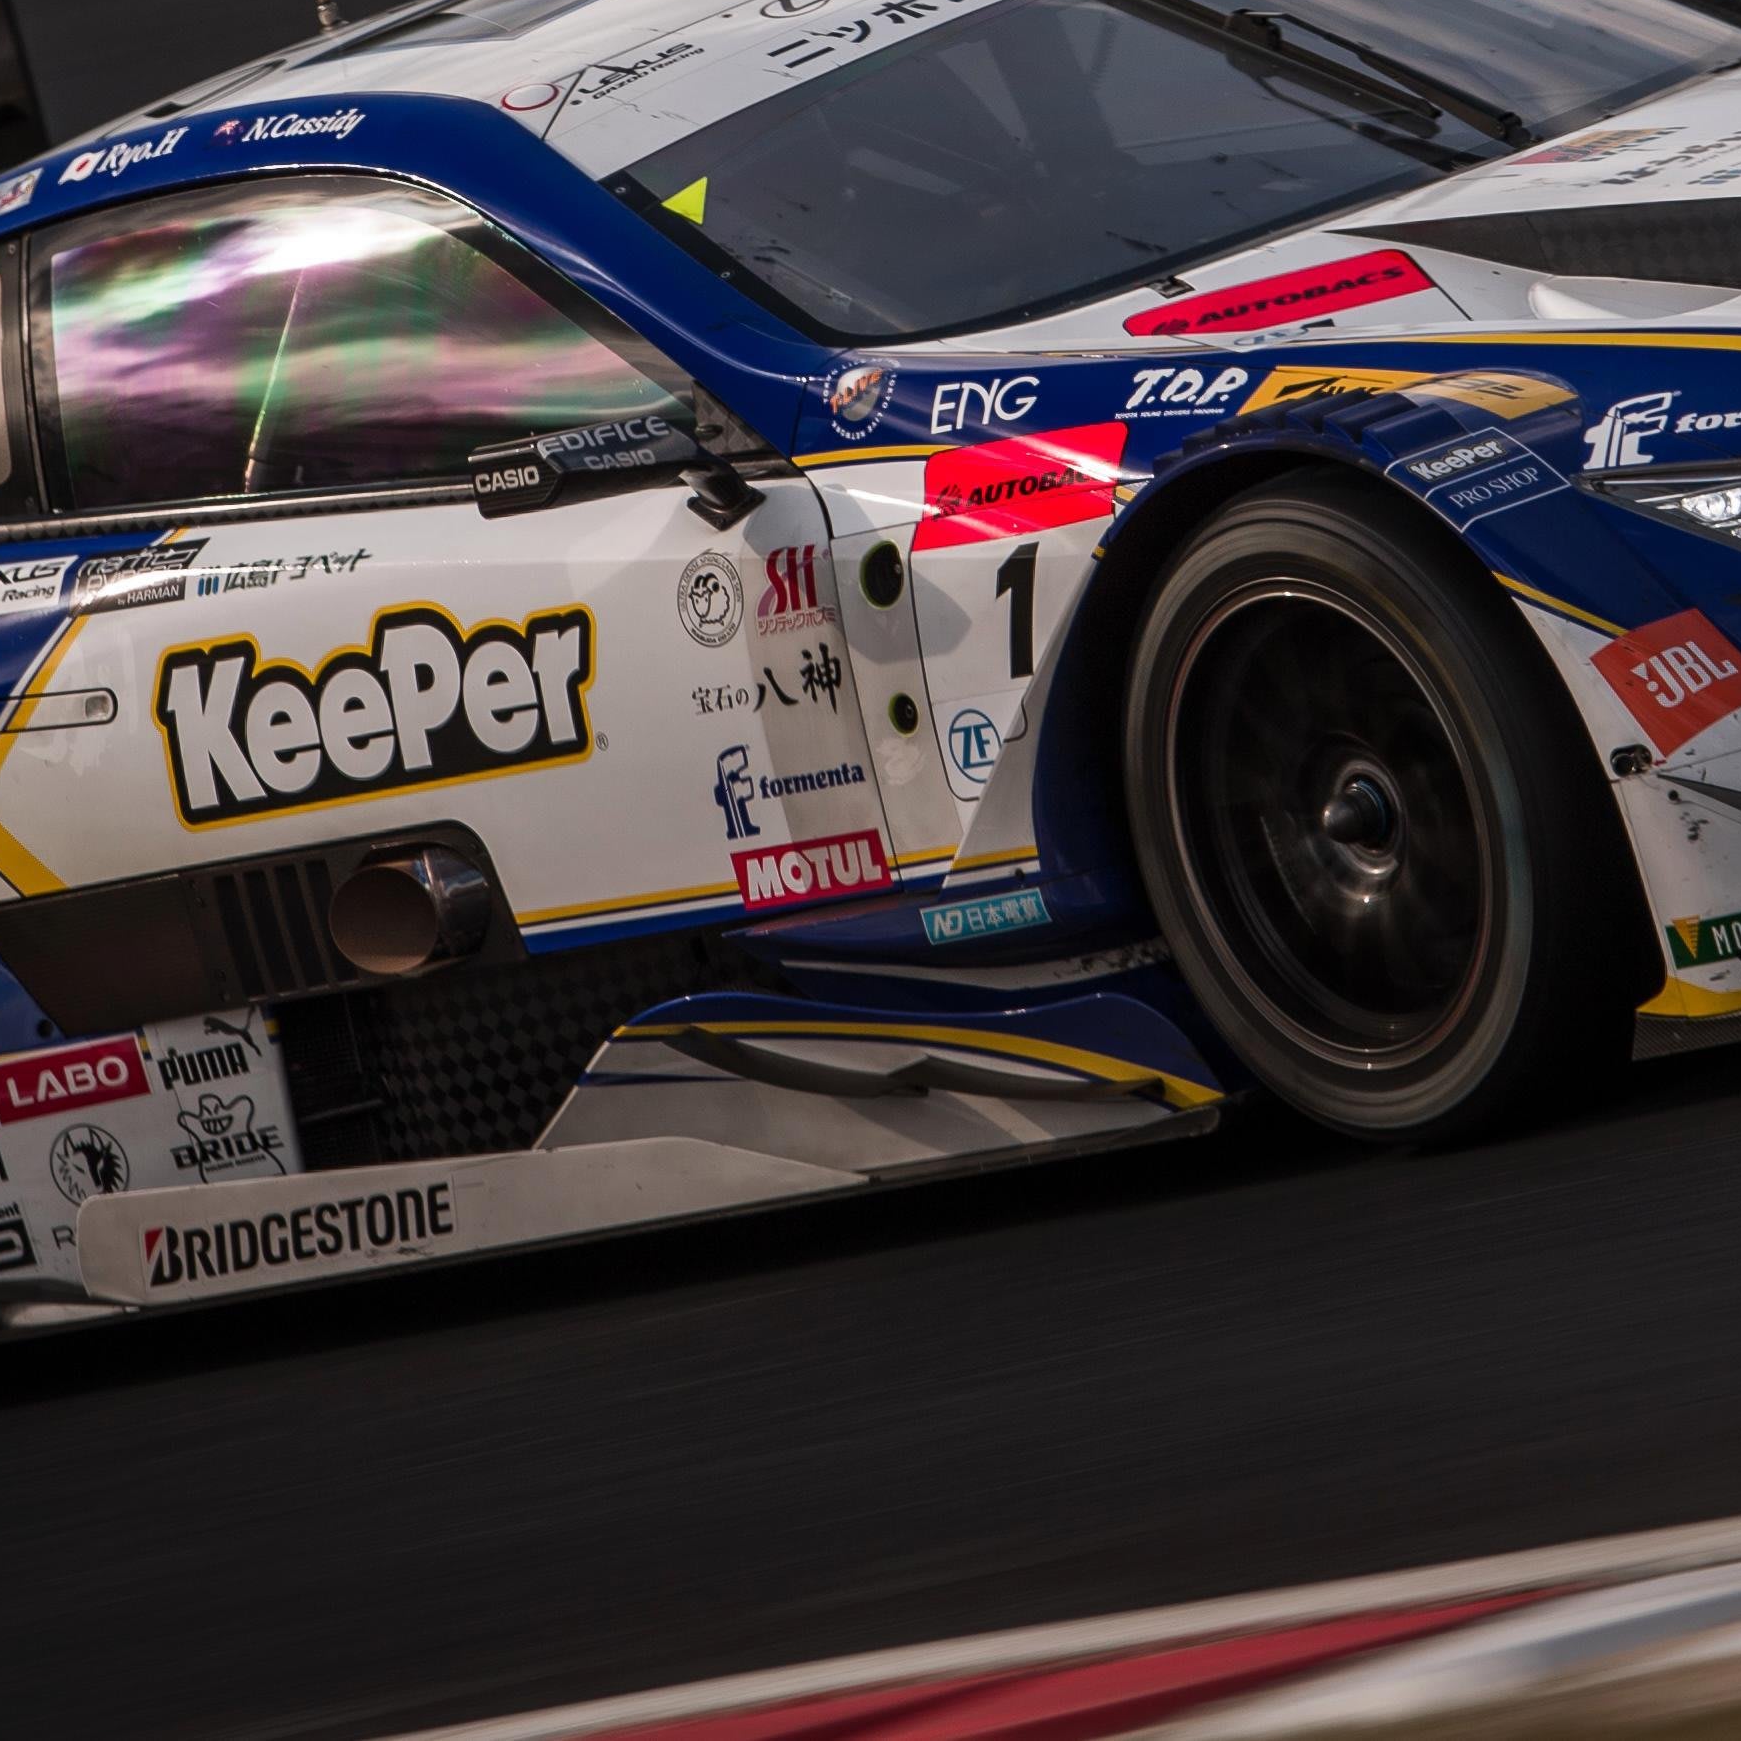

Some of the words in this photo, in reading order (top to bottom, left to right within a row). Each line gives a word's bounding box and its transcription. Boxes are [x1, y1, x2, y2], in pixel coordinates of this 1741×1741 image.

[578, 42, 694, 94] LEXUS
[241, 107, 367, 143] N.Cassidy
[1196, 265, 1406, 325] AUTOBACS
[929, 375, 1041, 436] ENG
[537, 415, 671, 460] EDIFICE
[582, 447, 657, 471] CASIO
[1408, 438, 1506, 482] KeePer
[474, 464, 541, 494] CASIO
[1448, 485, 1493, 509] PRO
[1488, 466, 1539, 495] SHOP
[1, 585, 56, 603] Racing
[126, 584, 180, 605] HARMAN
[994, 541, 1041, 680] 1
[1647, 640, 1739, 708] JBL
[162, 616, 587, 818] KeePer
[953, 721, 997, 770] ZF
[758, 762, 867, 800] formenta
[745, 838, 883, 904] MOTUL
[5, 1055, 130, 1109] LABO
[158, 1042, 251, 1091] PUMA
[169, 1124, 285, 1171] BRIDE
[143, 1182, 454, 1288] BRIDGESTONE
